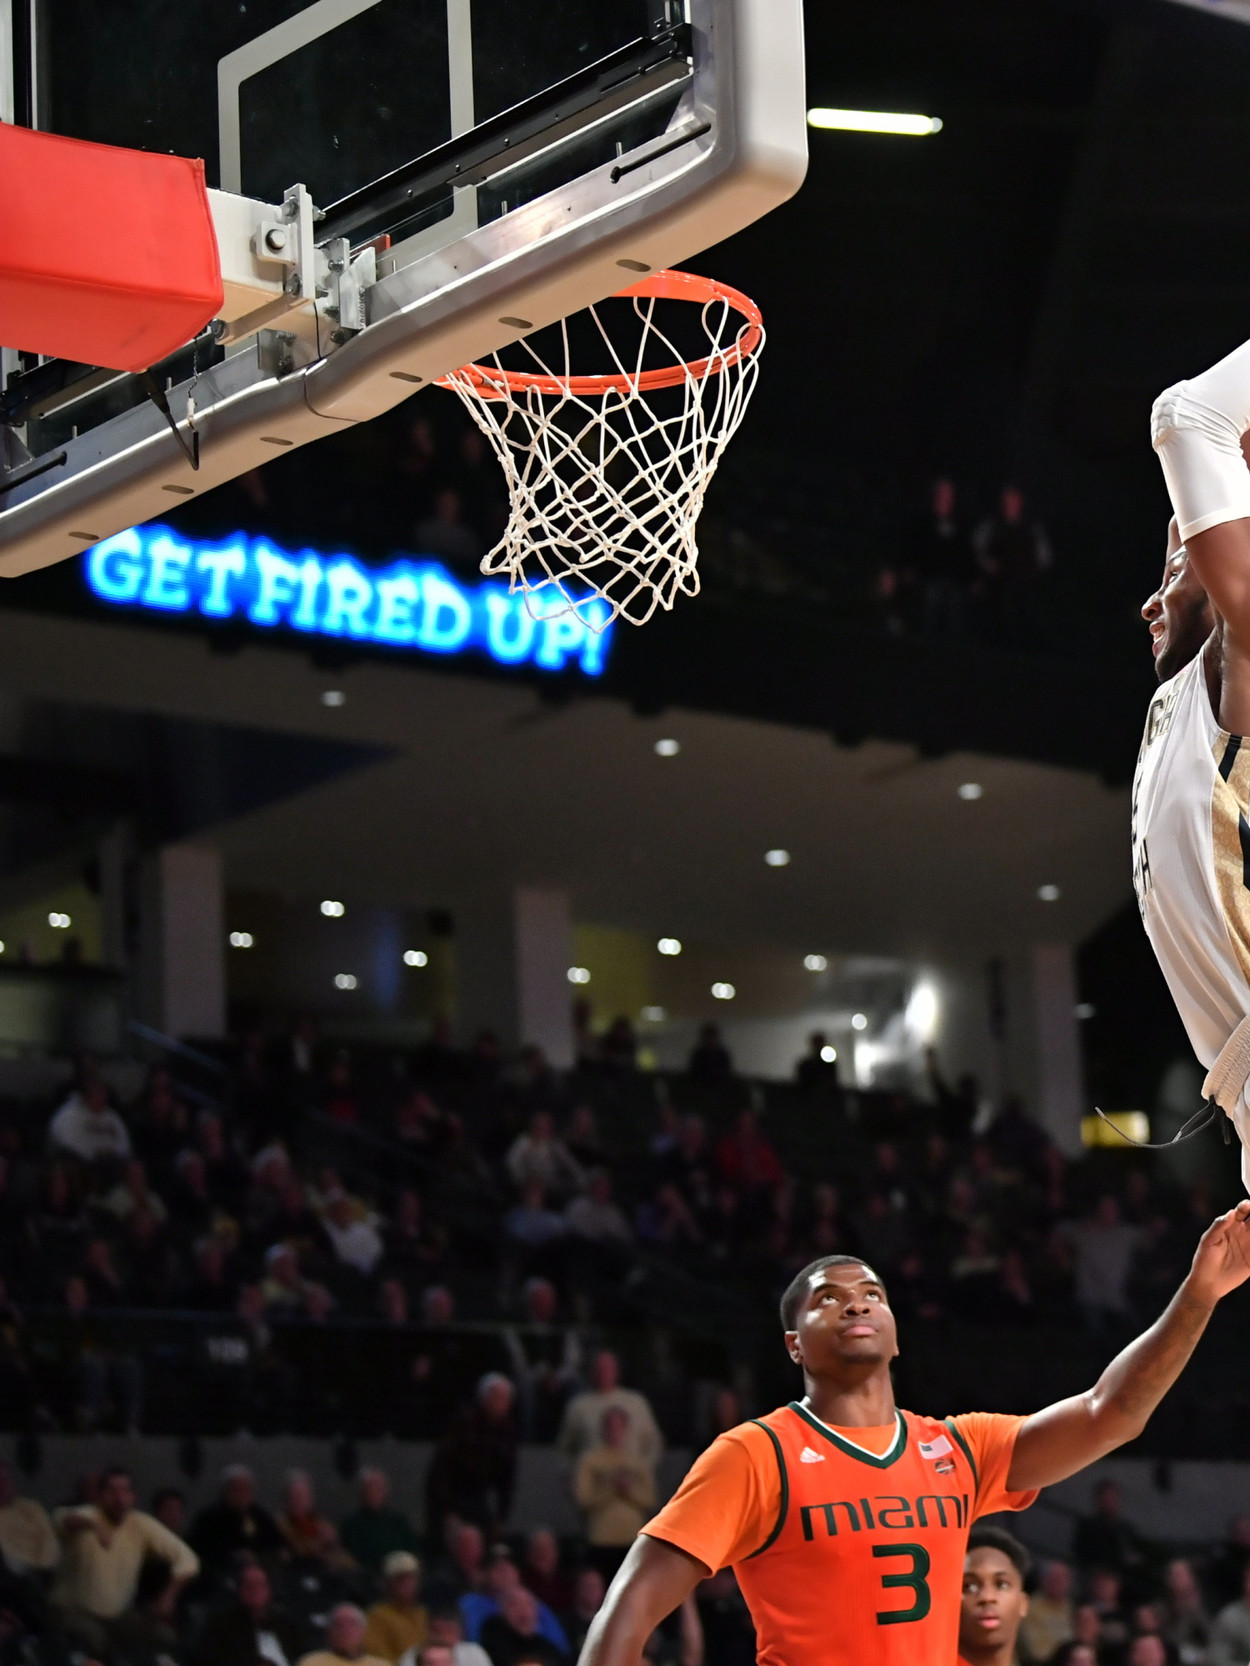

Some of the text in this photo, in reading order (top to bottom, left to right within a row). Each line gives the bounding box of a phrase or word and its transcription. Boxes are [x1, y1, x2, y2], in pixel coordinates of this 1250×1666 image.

[90, 526, 605, 674] GET FIRED UP!
[872, 1543, 931, 1625] 3
